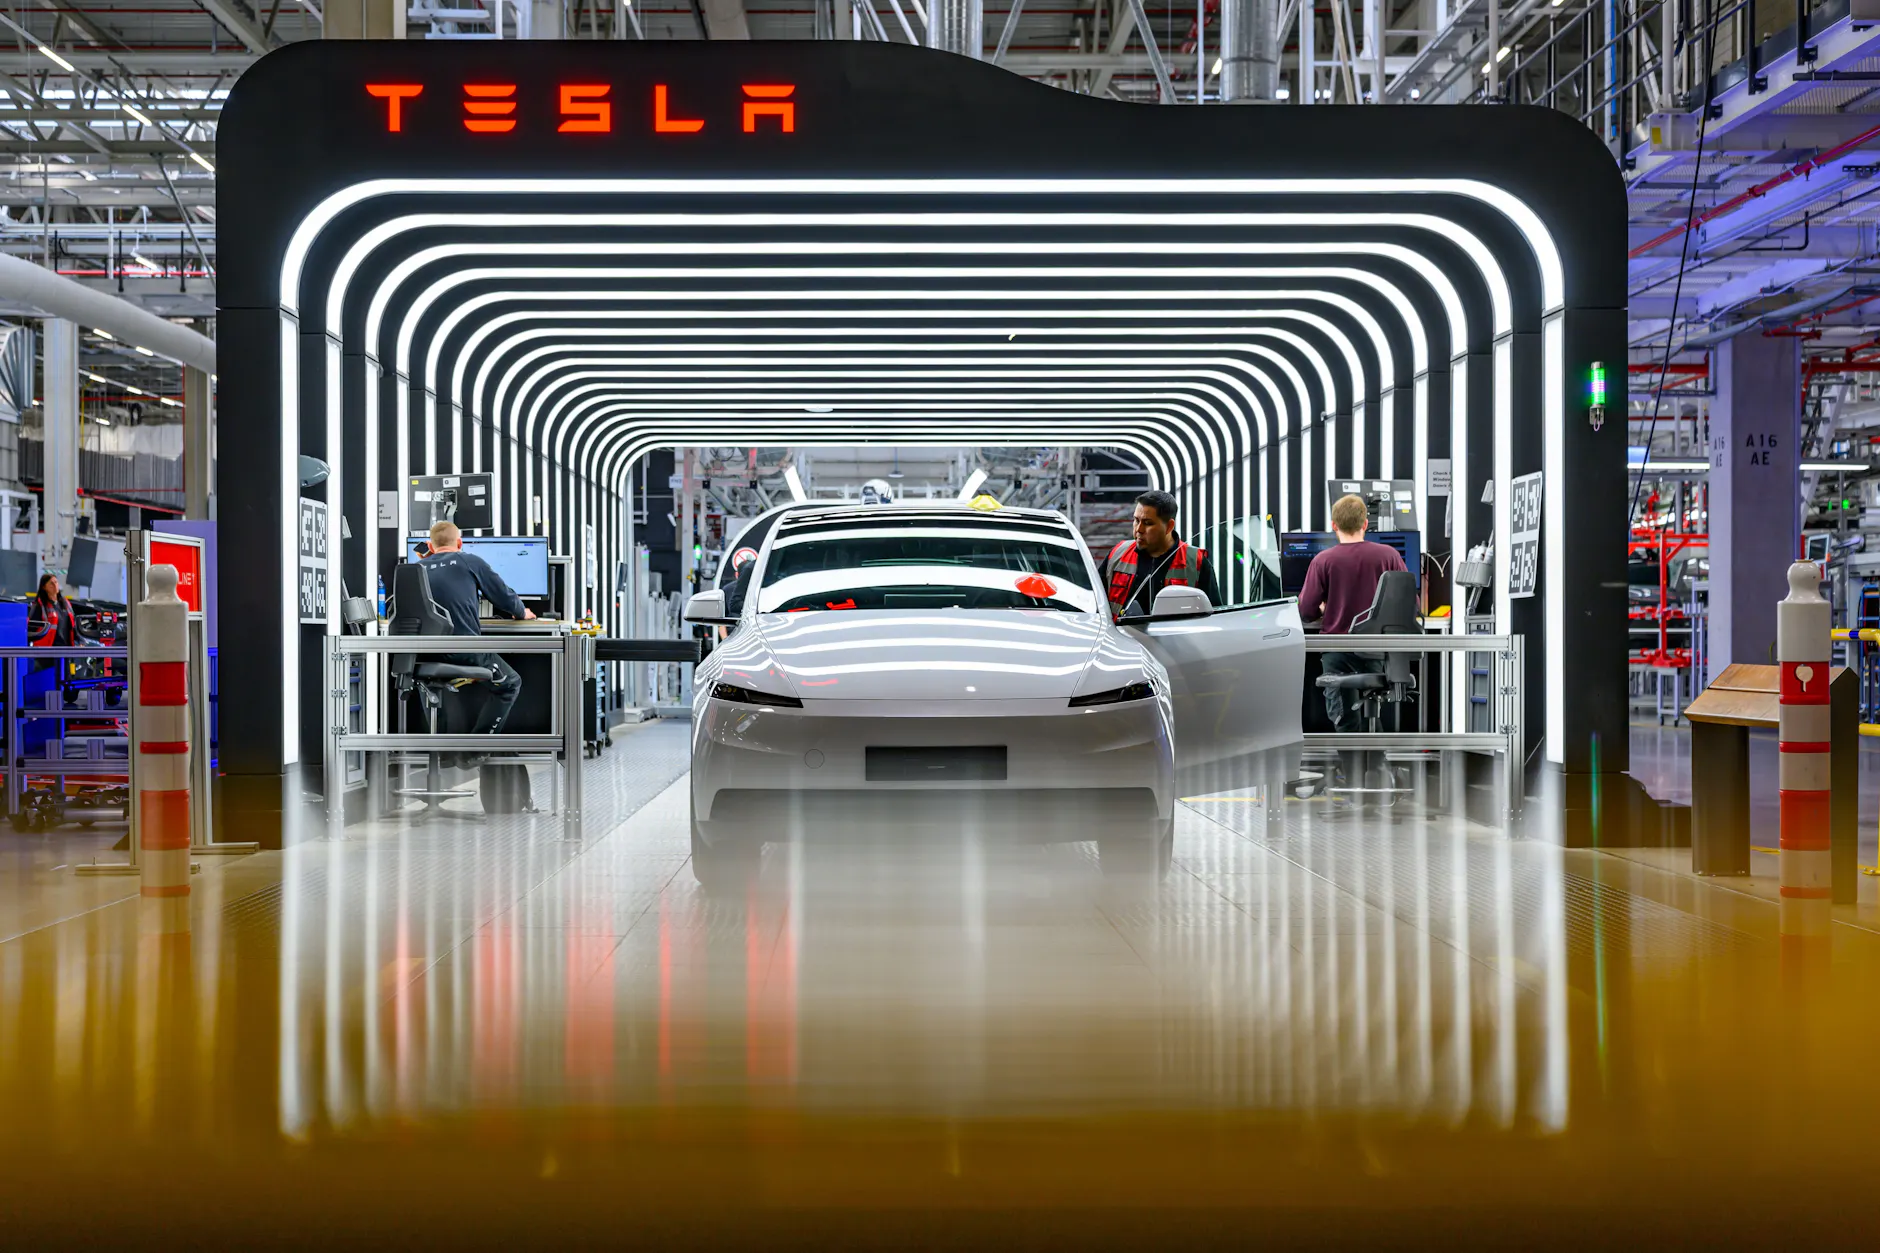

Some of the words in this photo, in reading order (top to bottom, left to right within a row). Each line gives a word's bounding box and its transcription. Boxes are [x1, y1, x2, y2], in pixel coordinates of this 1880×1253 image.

[365, 84, 796, 132] TESLA
[1714, 436, 1725, 450] A16
[1746, 433, 1777, 448] A16
[1716, 453, 1722, 467] AE
[1751, 451, 1770, 466] AE
